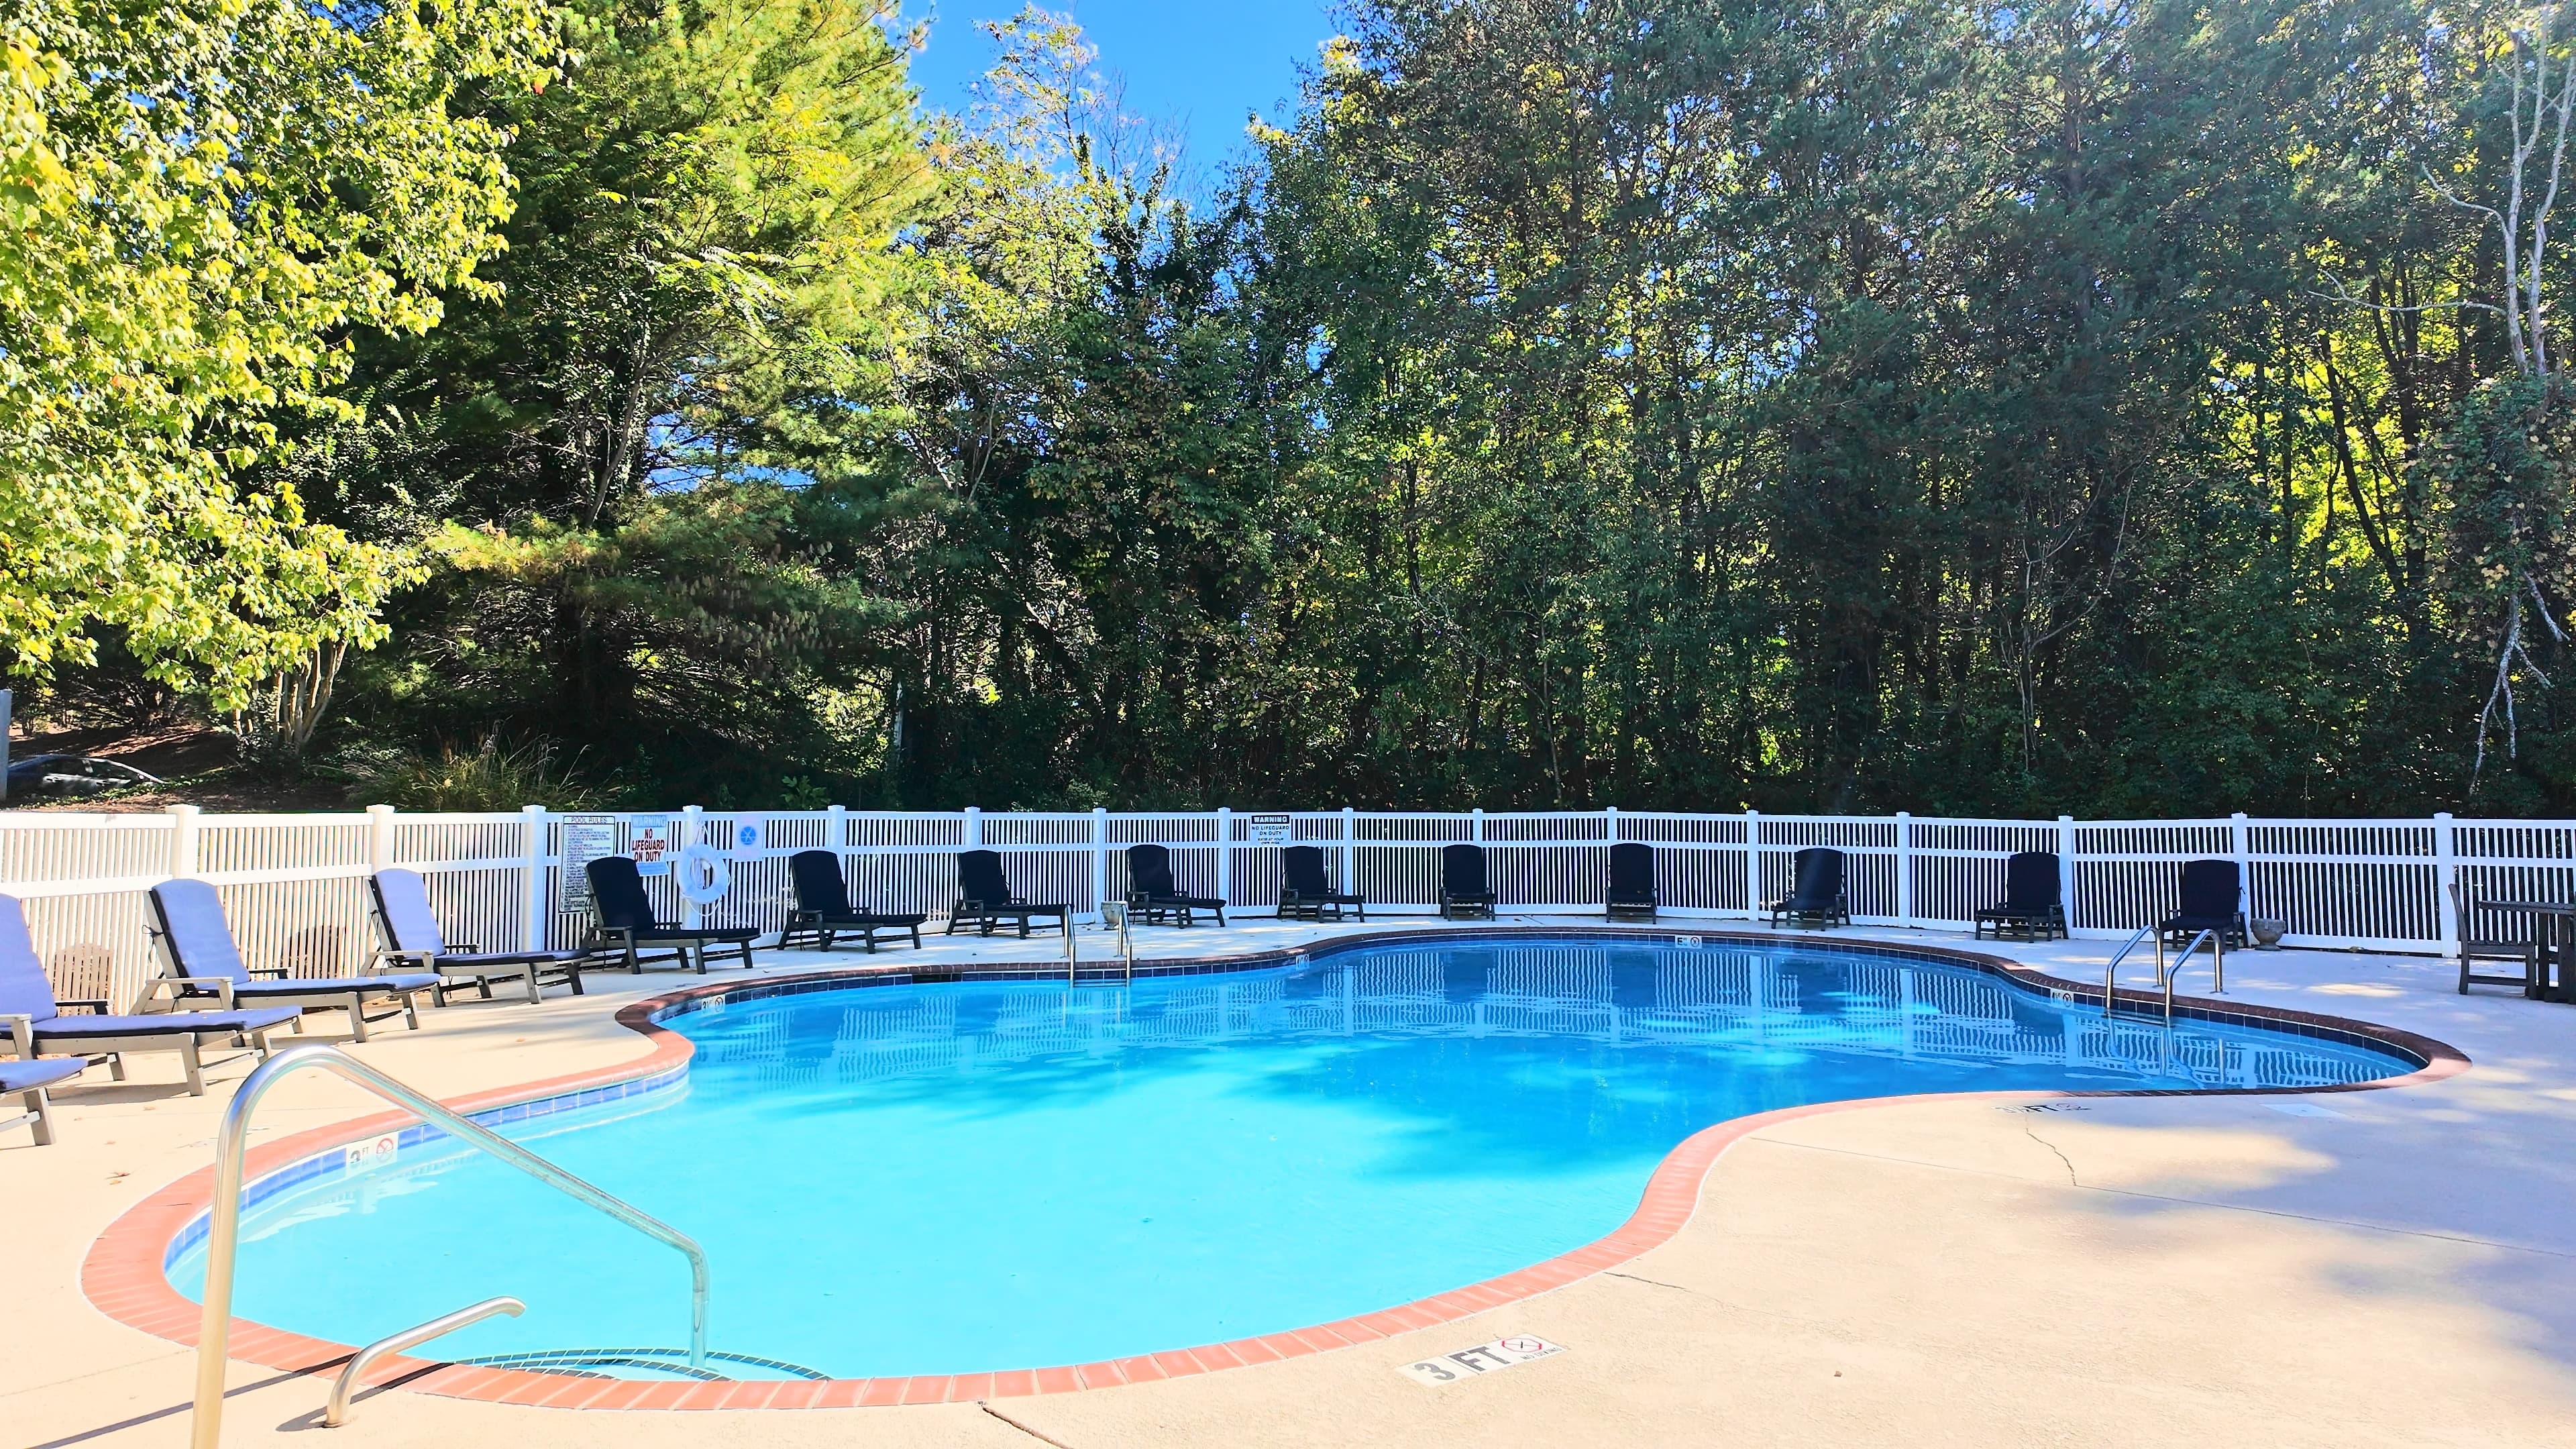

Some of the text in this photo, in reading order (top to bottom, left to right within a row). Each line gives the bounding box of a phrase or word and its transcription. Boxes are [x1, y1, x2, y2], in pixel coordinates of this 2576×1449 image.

[633, 816, 665, 827] WARNING
[645, 828, 653, 839] NO
[632, 840, 665, 851] LIFEGUARD
[634, 851, 661, 862] ON DUTY
[1414, 1346, 1511, 1380] 3 FT
